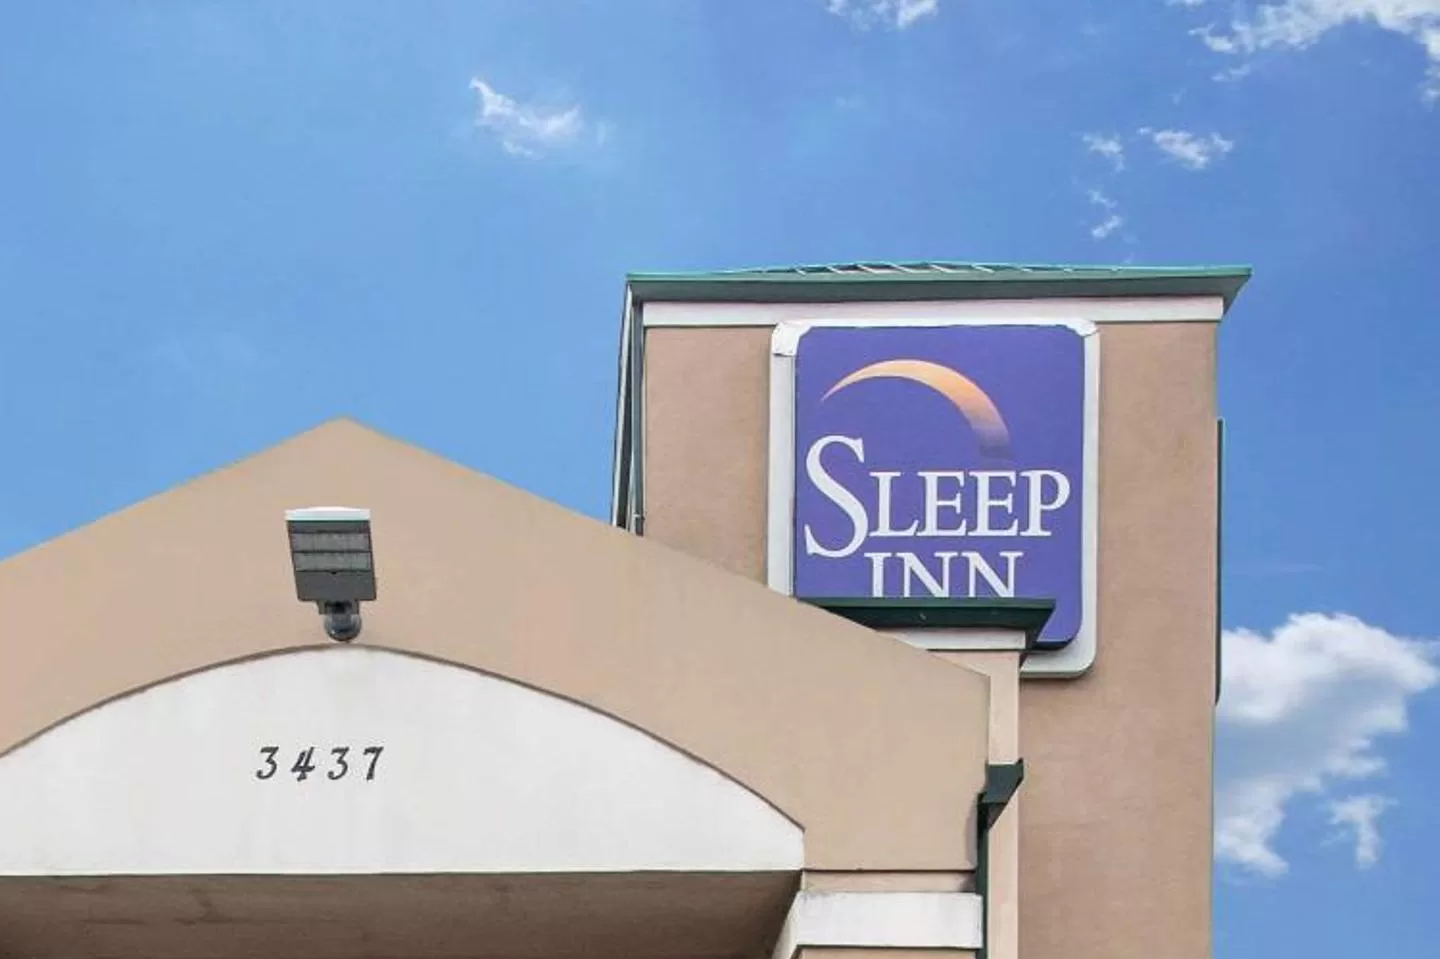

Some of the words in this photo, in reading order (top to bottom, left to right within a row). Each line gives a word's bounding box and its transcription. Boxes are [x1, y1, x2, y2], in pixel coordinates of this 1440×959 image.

[804, 435, 1071, 558] SLEEP
[864, 551, 1024, 598] INN
[256, 746, 384, 782] 3437
